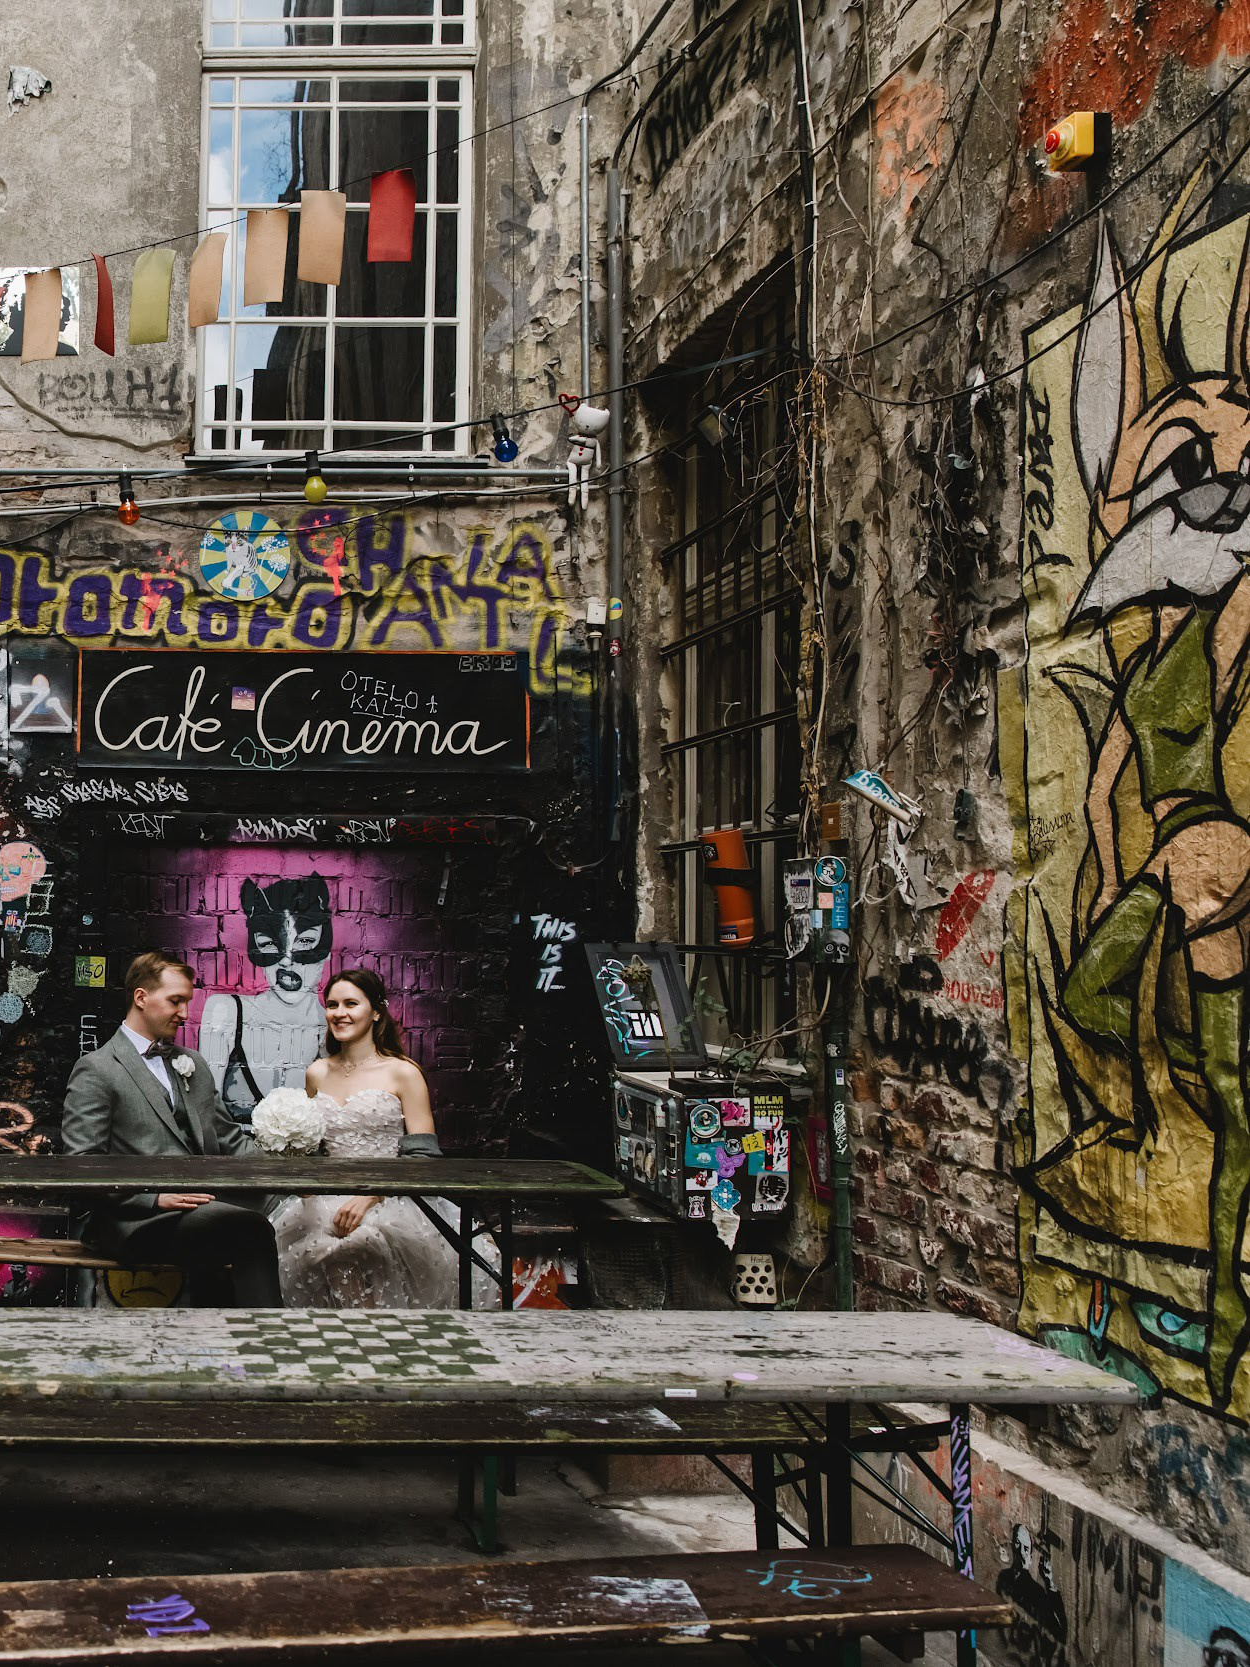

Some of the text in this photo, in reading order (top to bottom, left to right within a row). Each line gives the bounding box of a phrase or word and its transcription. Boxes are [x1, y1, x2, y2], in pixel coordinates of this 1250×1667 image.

[340, 670, 419, 709] OTELO
[94, 665, 225, 760] Café
[350, 693, 406, 719] KALI
[530, 913, 576, 942] THIS
[541, 943, 562, 964] IS
[754, 1095, 784, 1105] MLM
